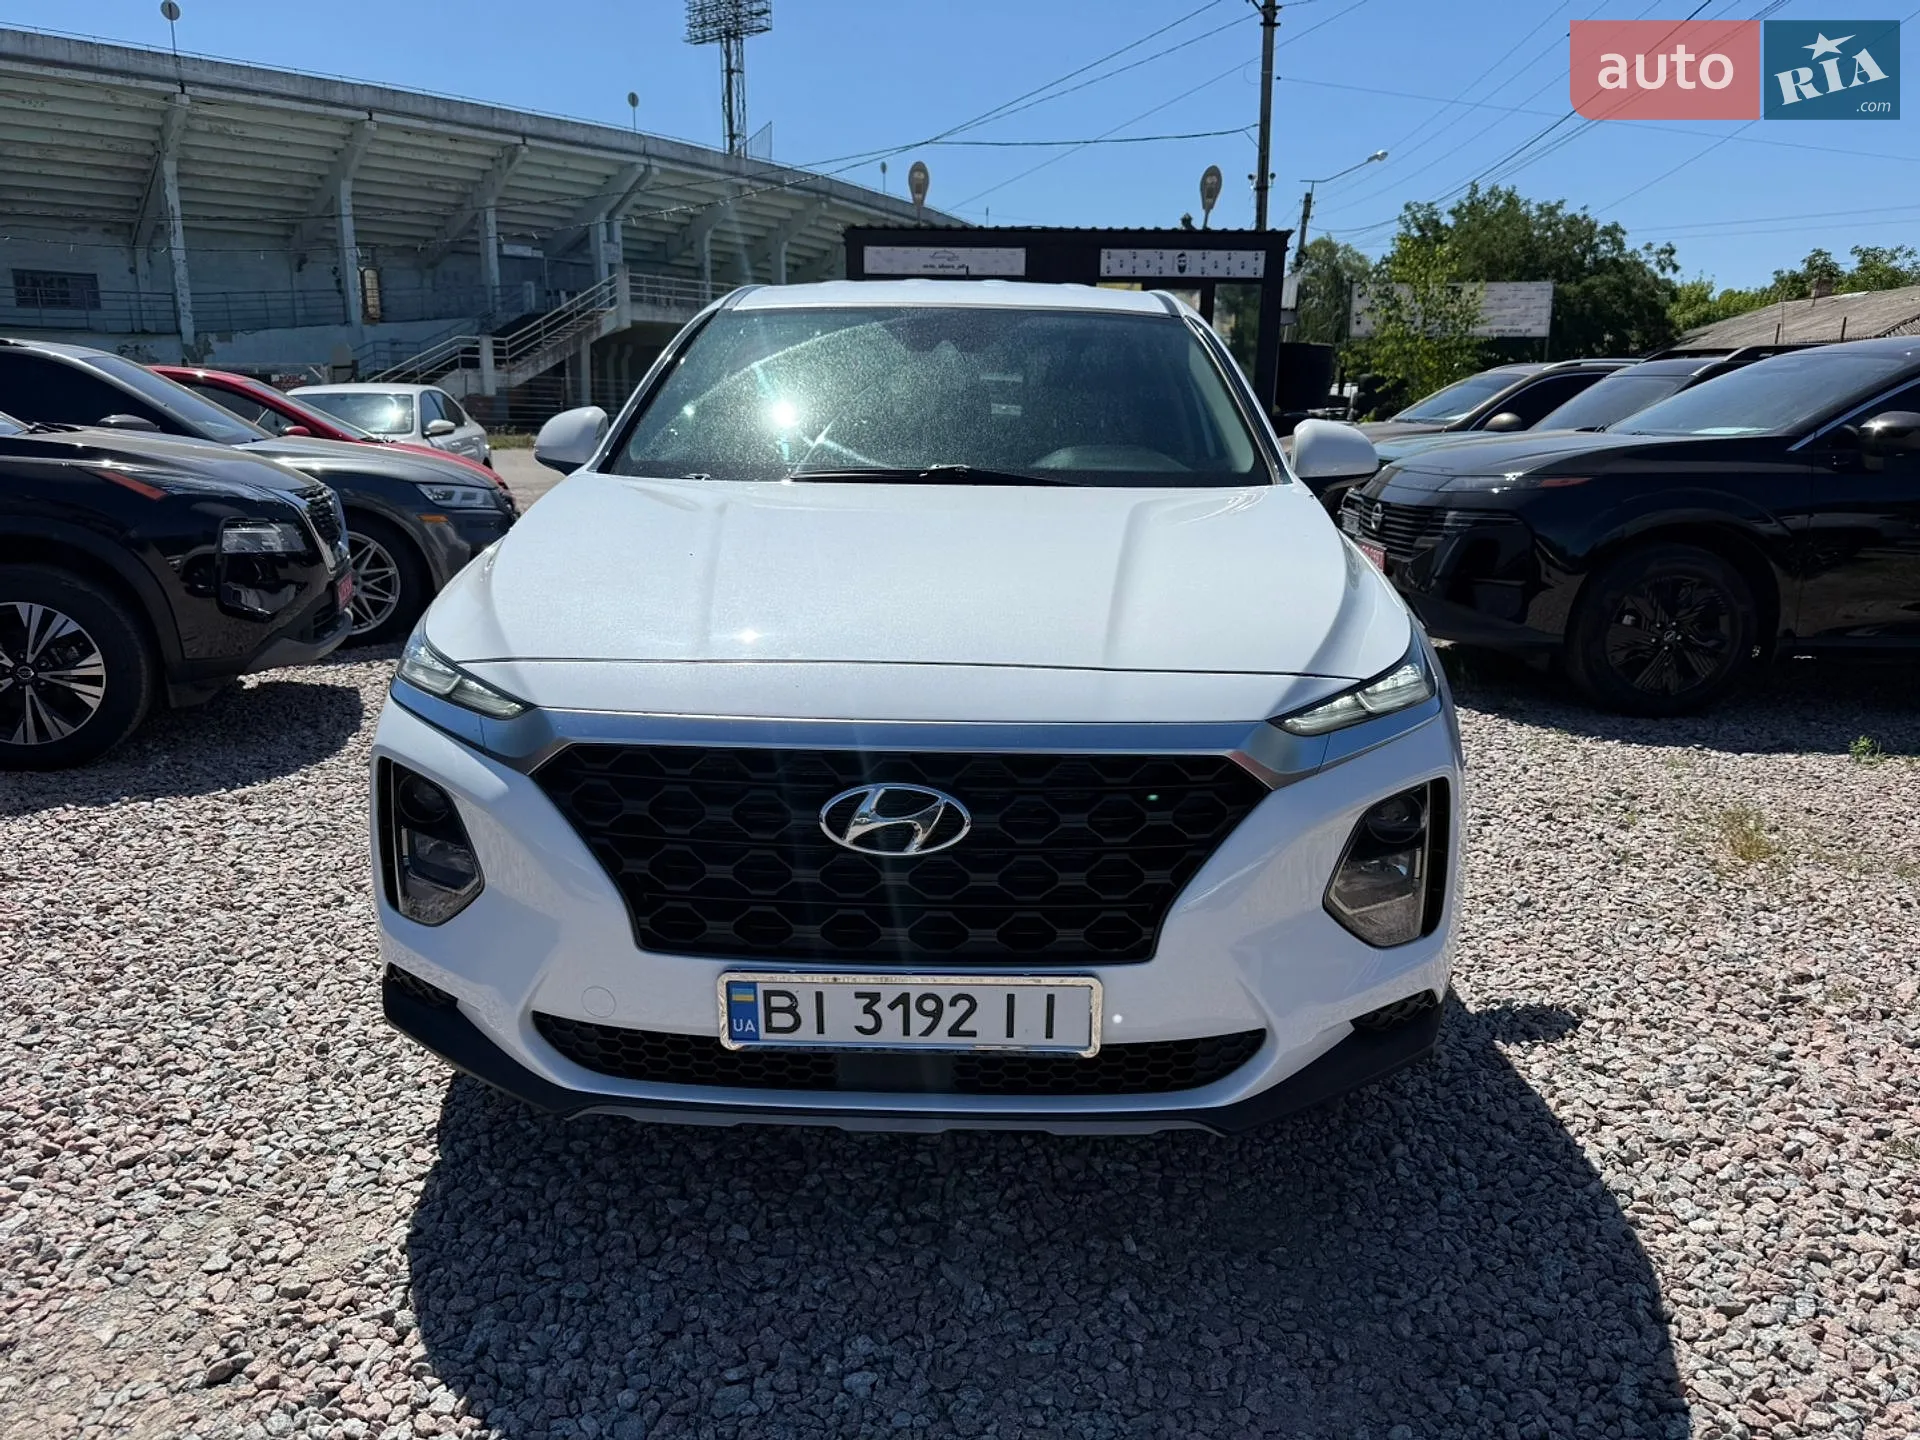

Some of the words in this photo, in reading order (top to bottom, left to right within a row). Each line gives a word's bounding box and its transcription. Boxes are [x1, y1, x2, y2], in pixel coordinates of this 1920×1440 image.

[733, 1019, 756, 1033] UA
[762, 989, 825, 1035] BI
[853, 991, 978, 1038] 3192
[1005, 993, 1056, 1040] II
